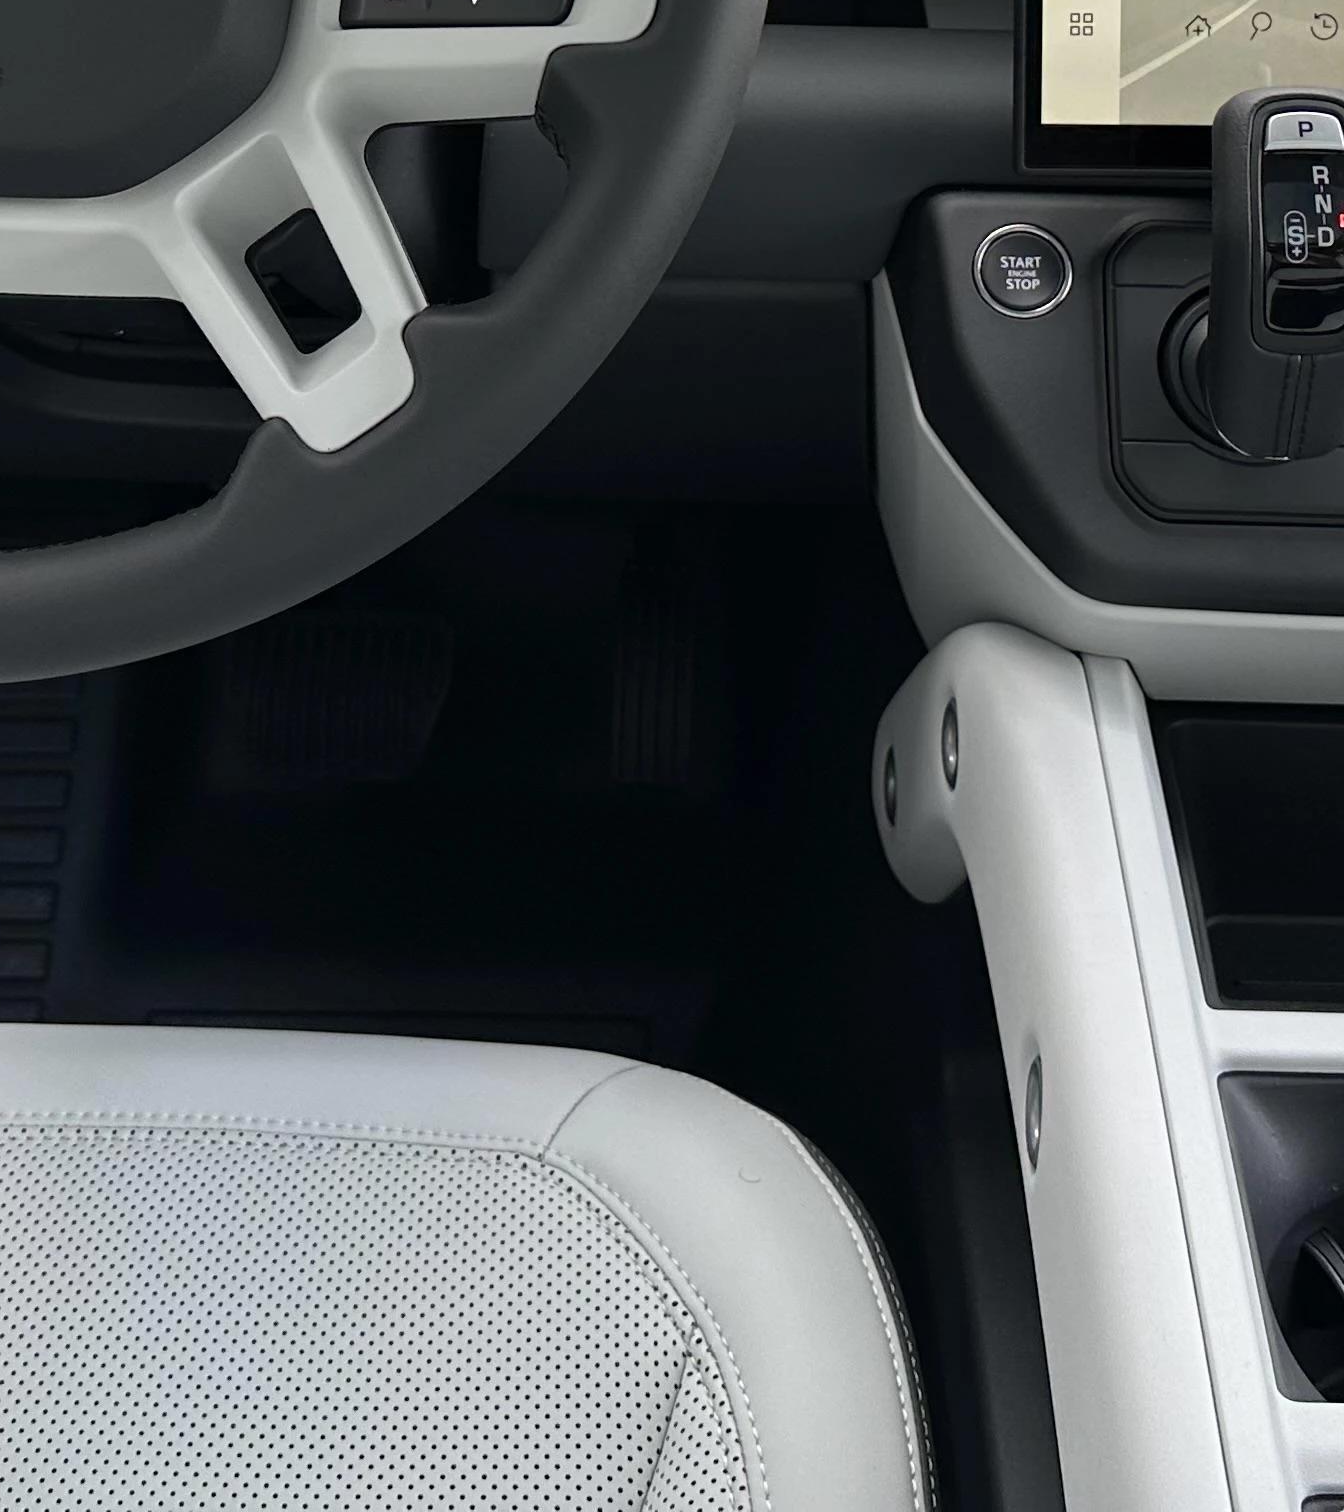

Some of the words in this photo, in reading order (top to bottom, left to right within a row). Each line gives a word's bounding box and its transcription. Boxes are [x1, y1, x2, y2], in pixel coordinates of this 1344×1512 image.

[1298, 121, 1313, 137] P
[1312, 166, 1329, 184] R
[1315, 194, 1332, 213] N
[1287, 226, 1304, 246] S
[1317, 227, 1334, 247] D
[999, 256, 1041, 268] START
[1006, 278, 1040, 290] STOP
